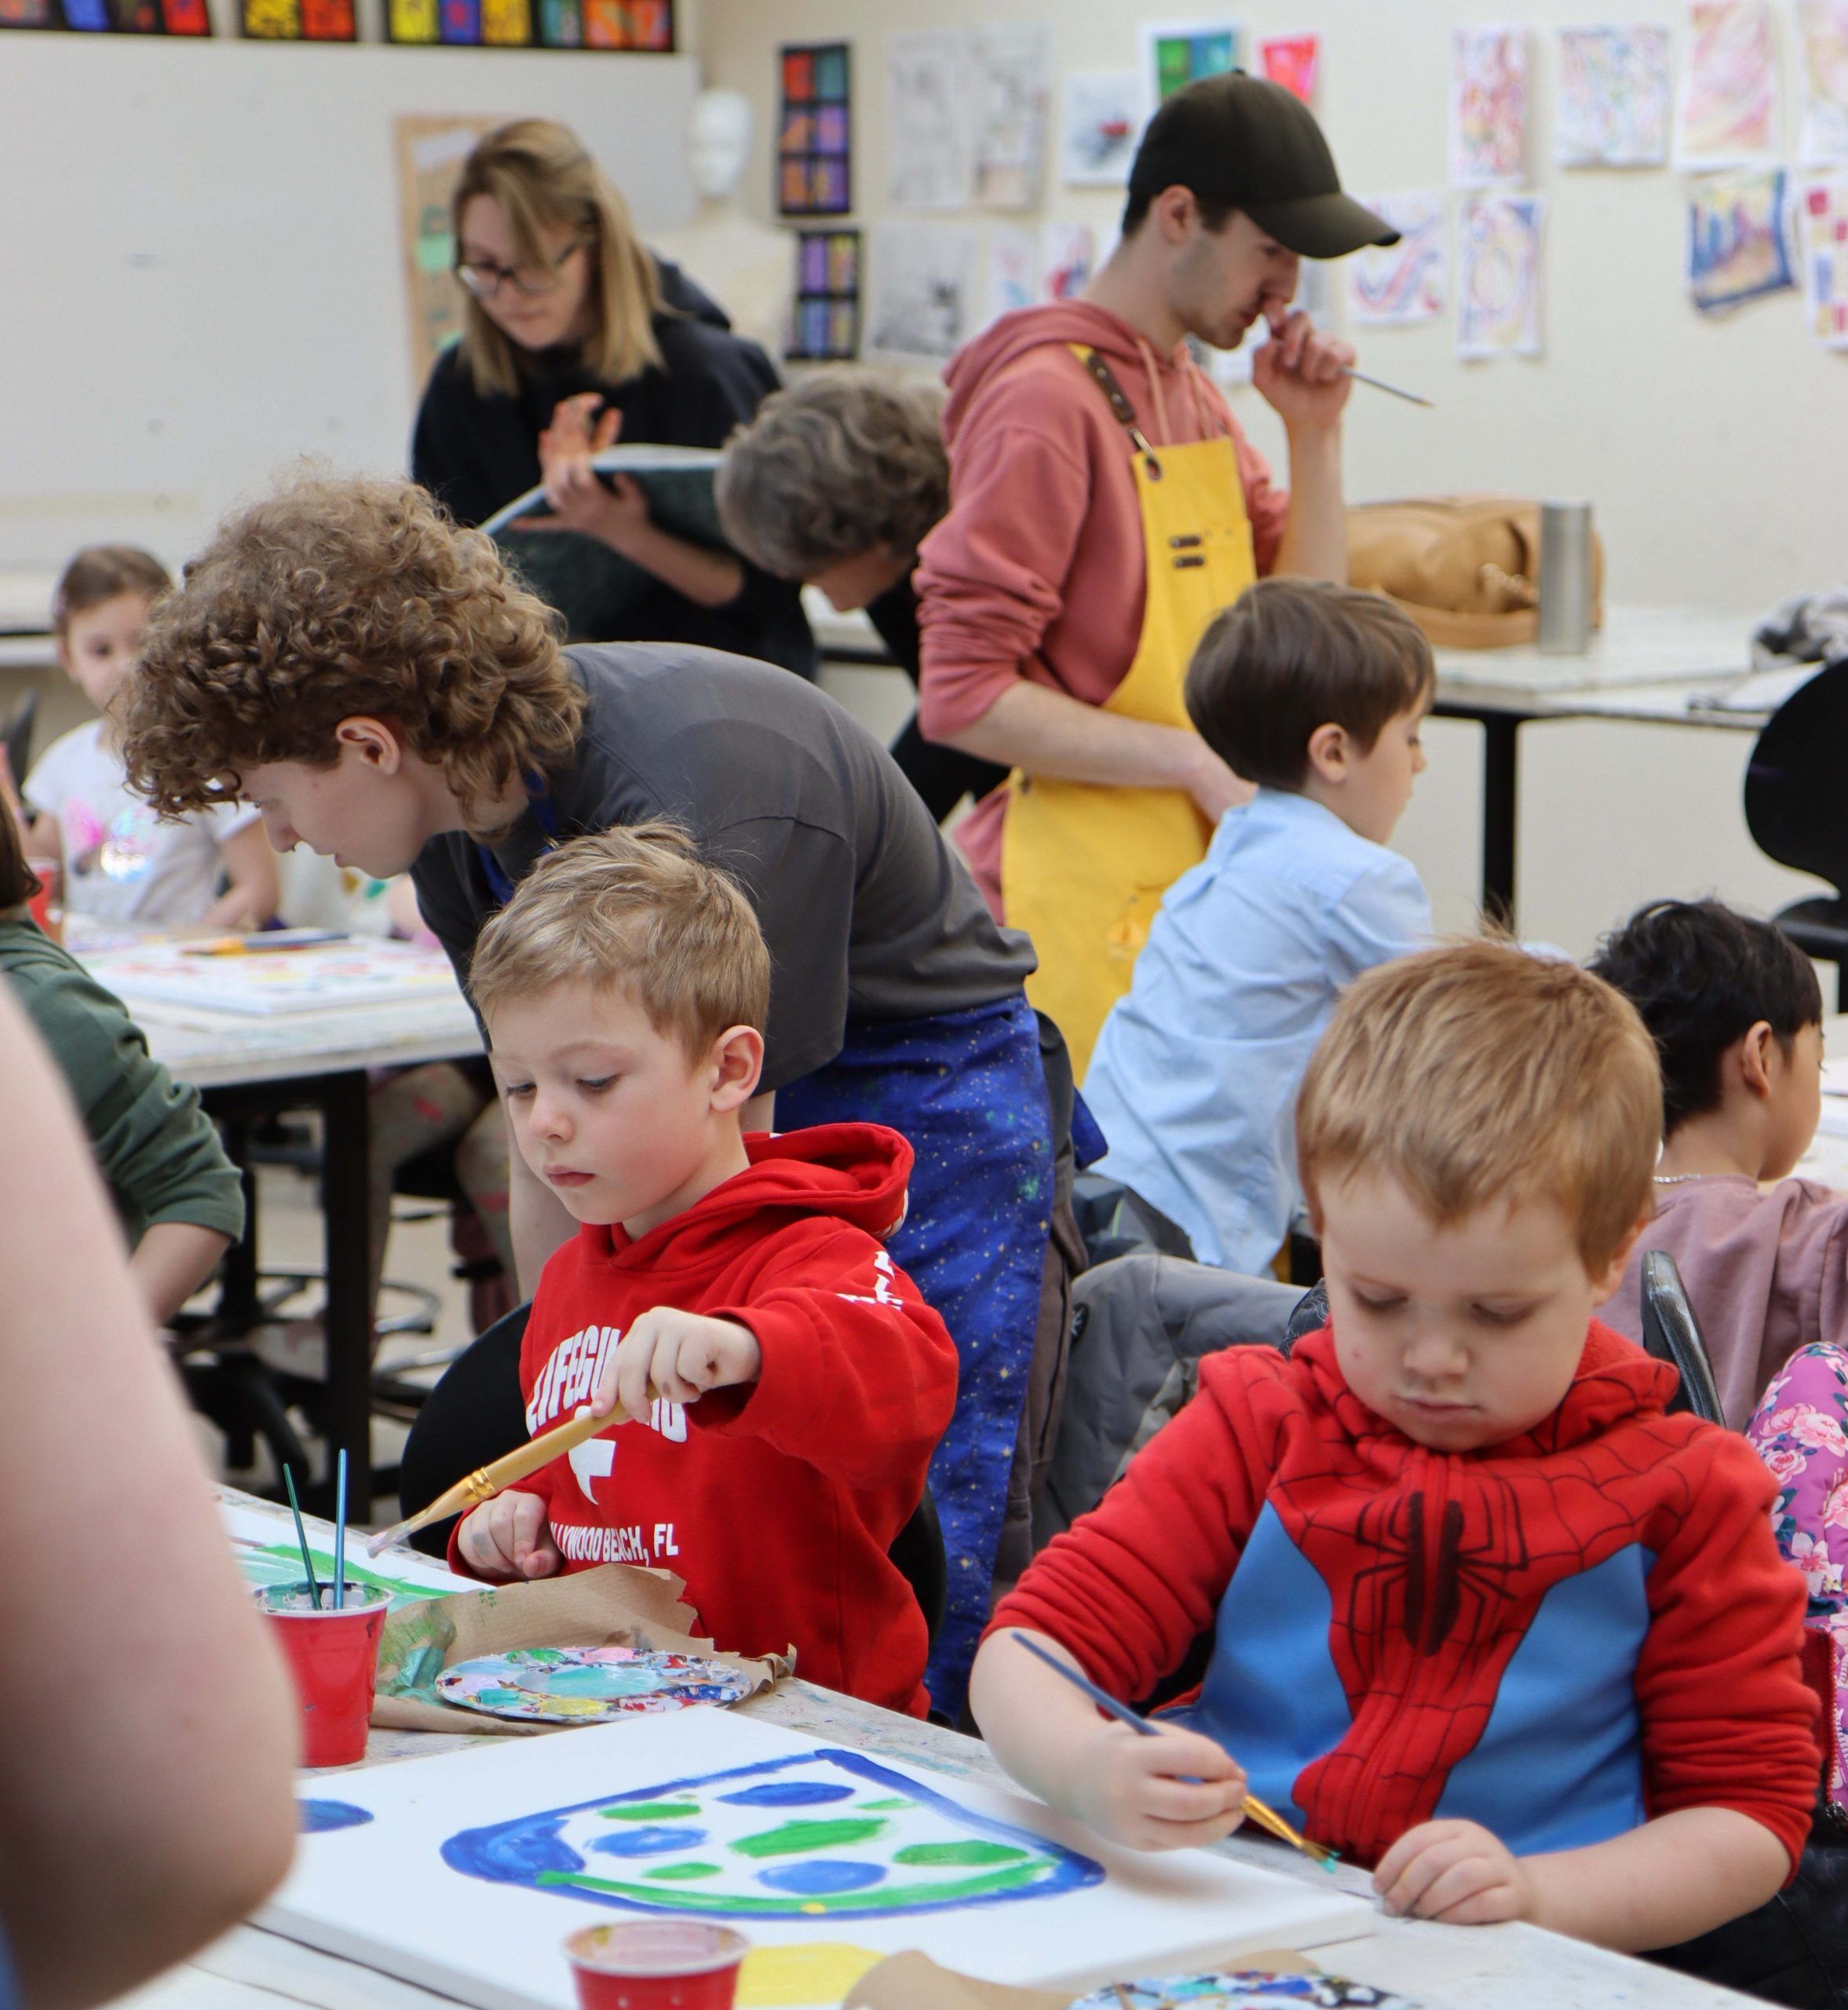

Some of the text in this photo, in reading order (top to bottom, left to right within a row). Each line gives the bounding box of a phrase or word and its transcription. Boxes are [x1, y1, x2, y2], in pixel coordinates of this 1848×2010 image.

[525, 1325, 688, 1443] LIFEGUD
[550, 1521, 603, 1562] LLYWOOD
[653, 1523, 678, 1558] FL
